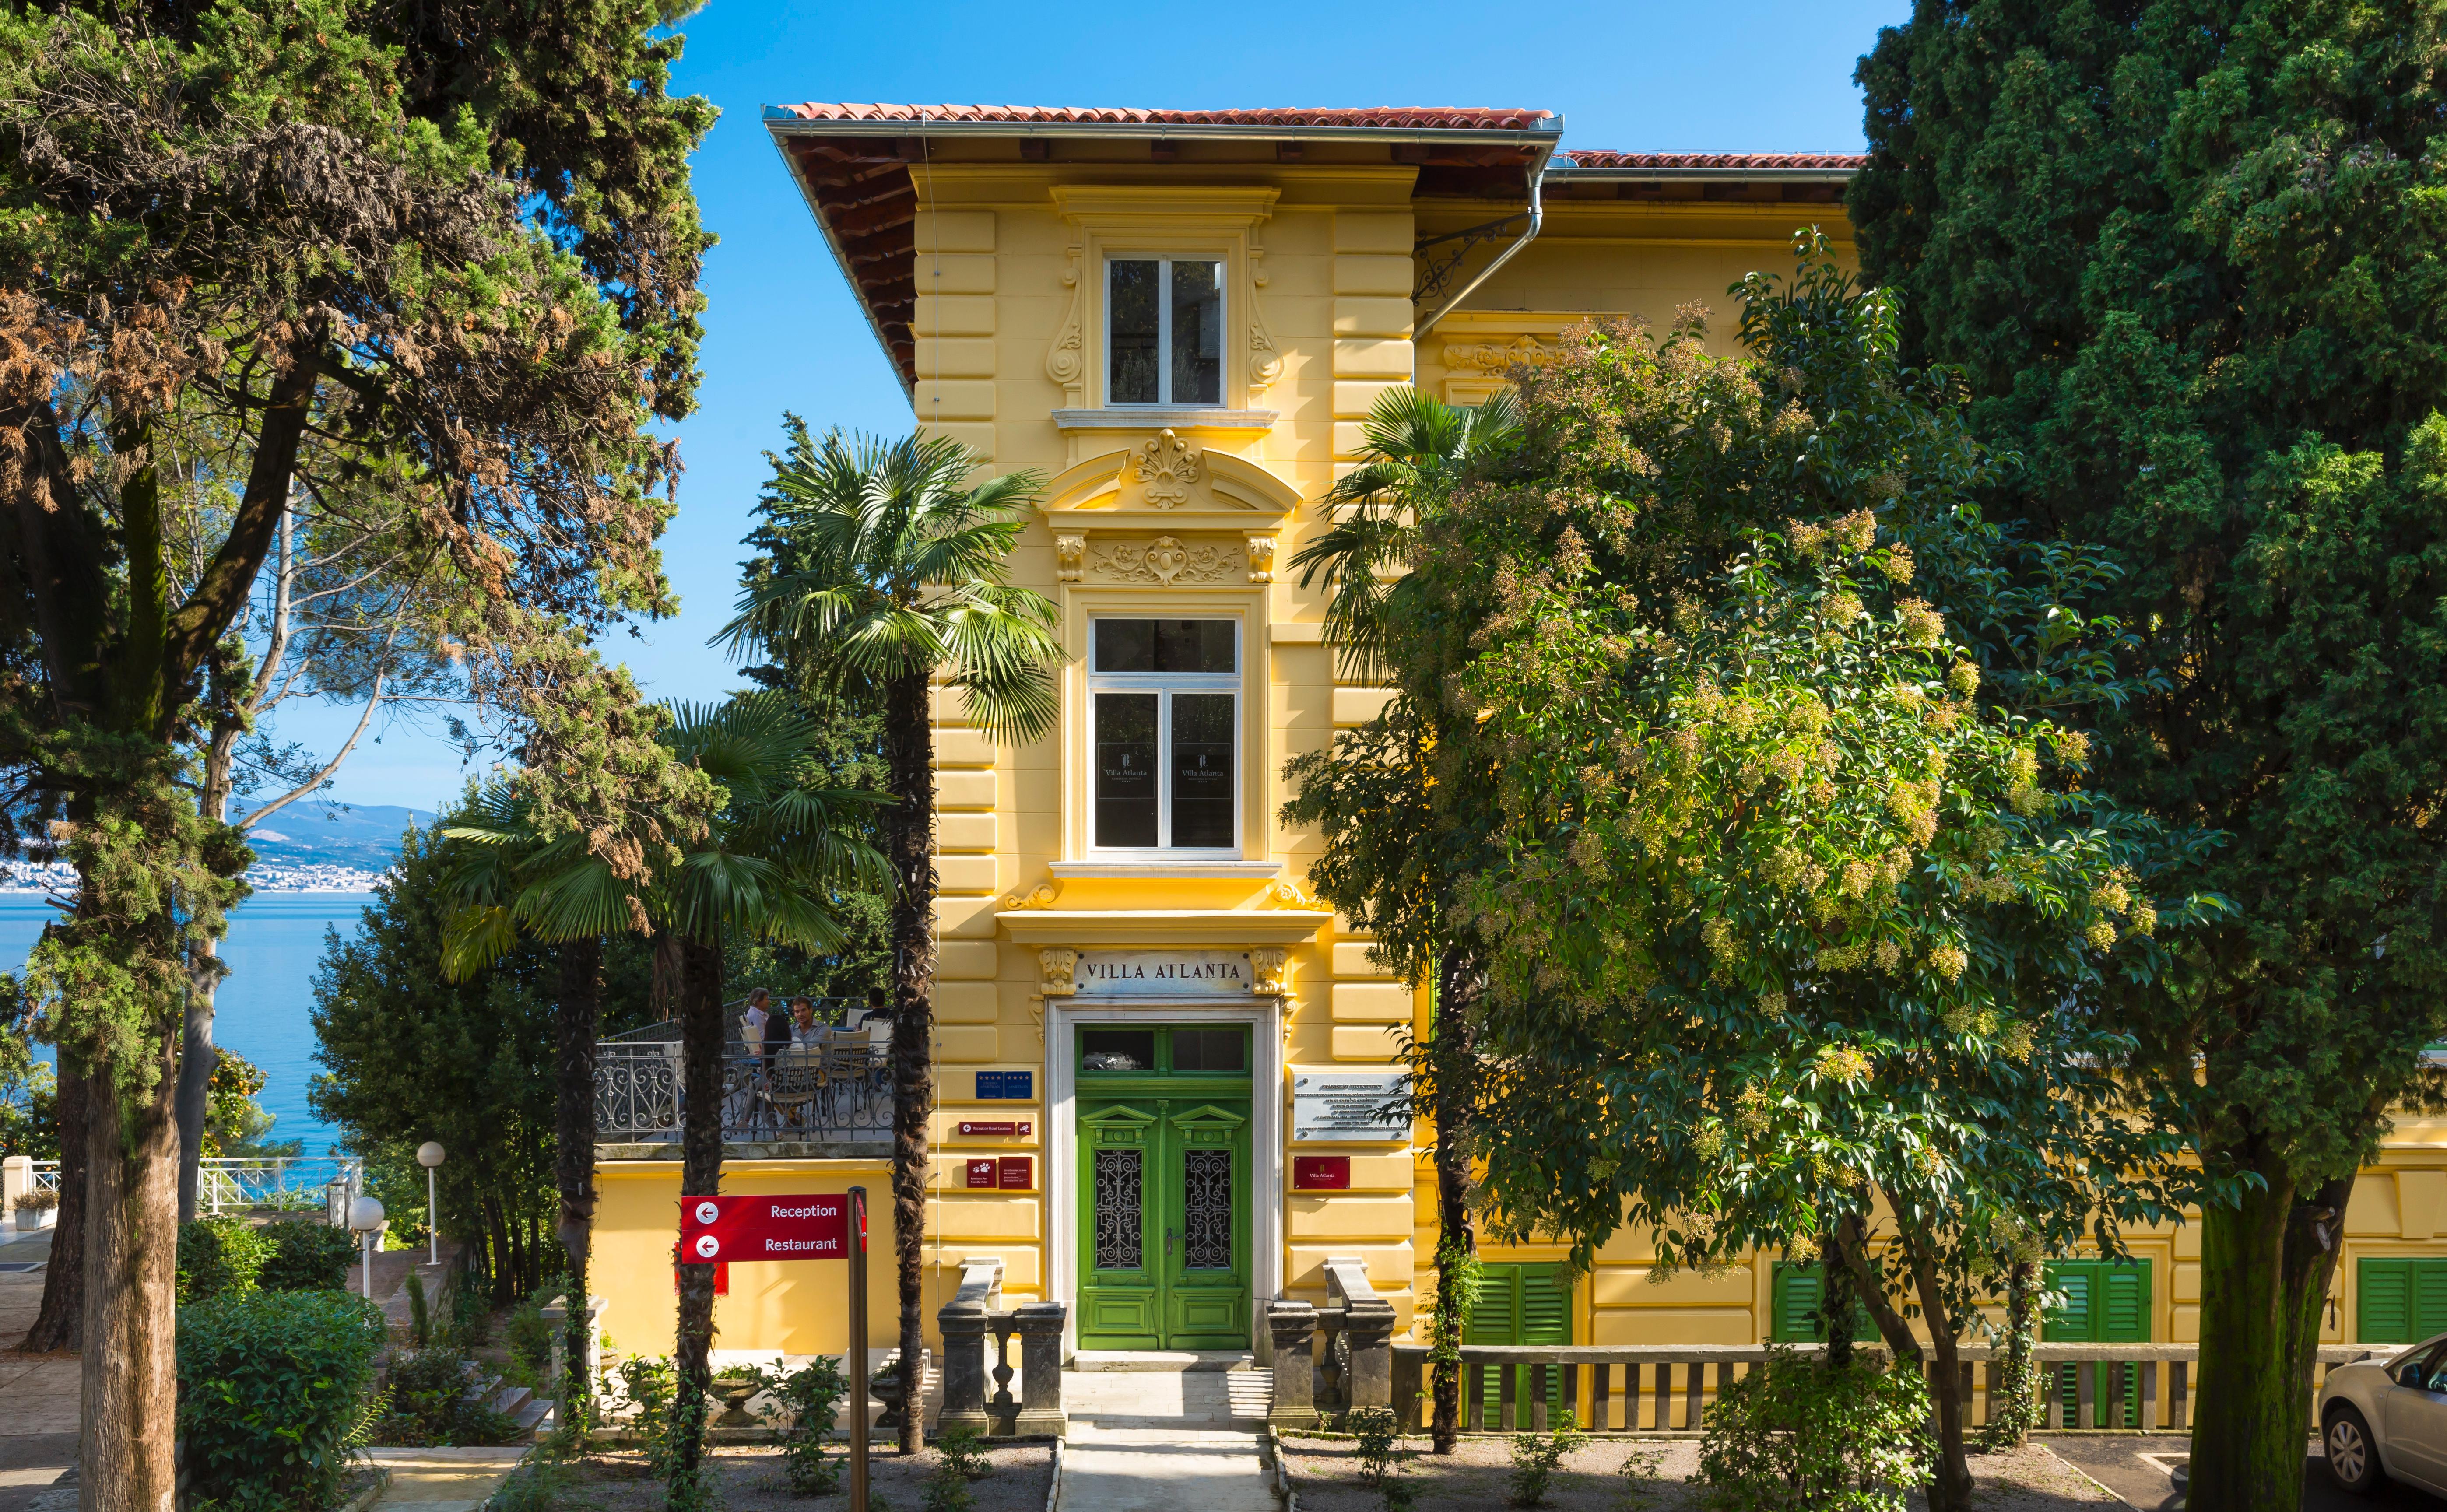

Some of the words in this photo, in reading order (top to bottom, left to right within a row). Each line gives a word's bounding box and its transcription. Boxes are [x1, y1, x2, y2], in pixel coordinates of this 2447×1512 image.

[1086, 964, 1145, 979] VILLA
[1155, 964, 1240, 979] ATLANTA
[771, 1205, 836, 1219] Reception
[766, 1238, 837, 1251] Restaurant
